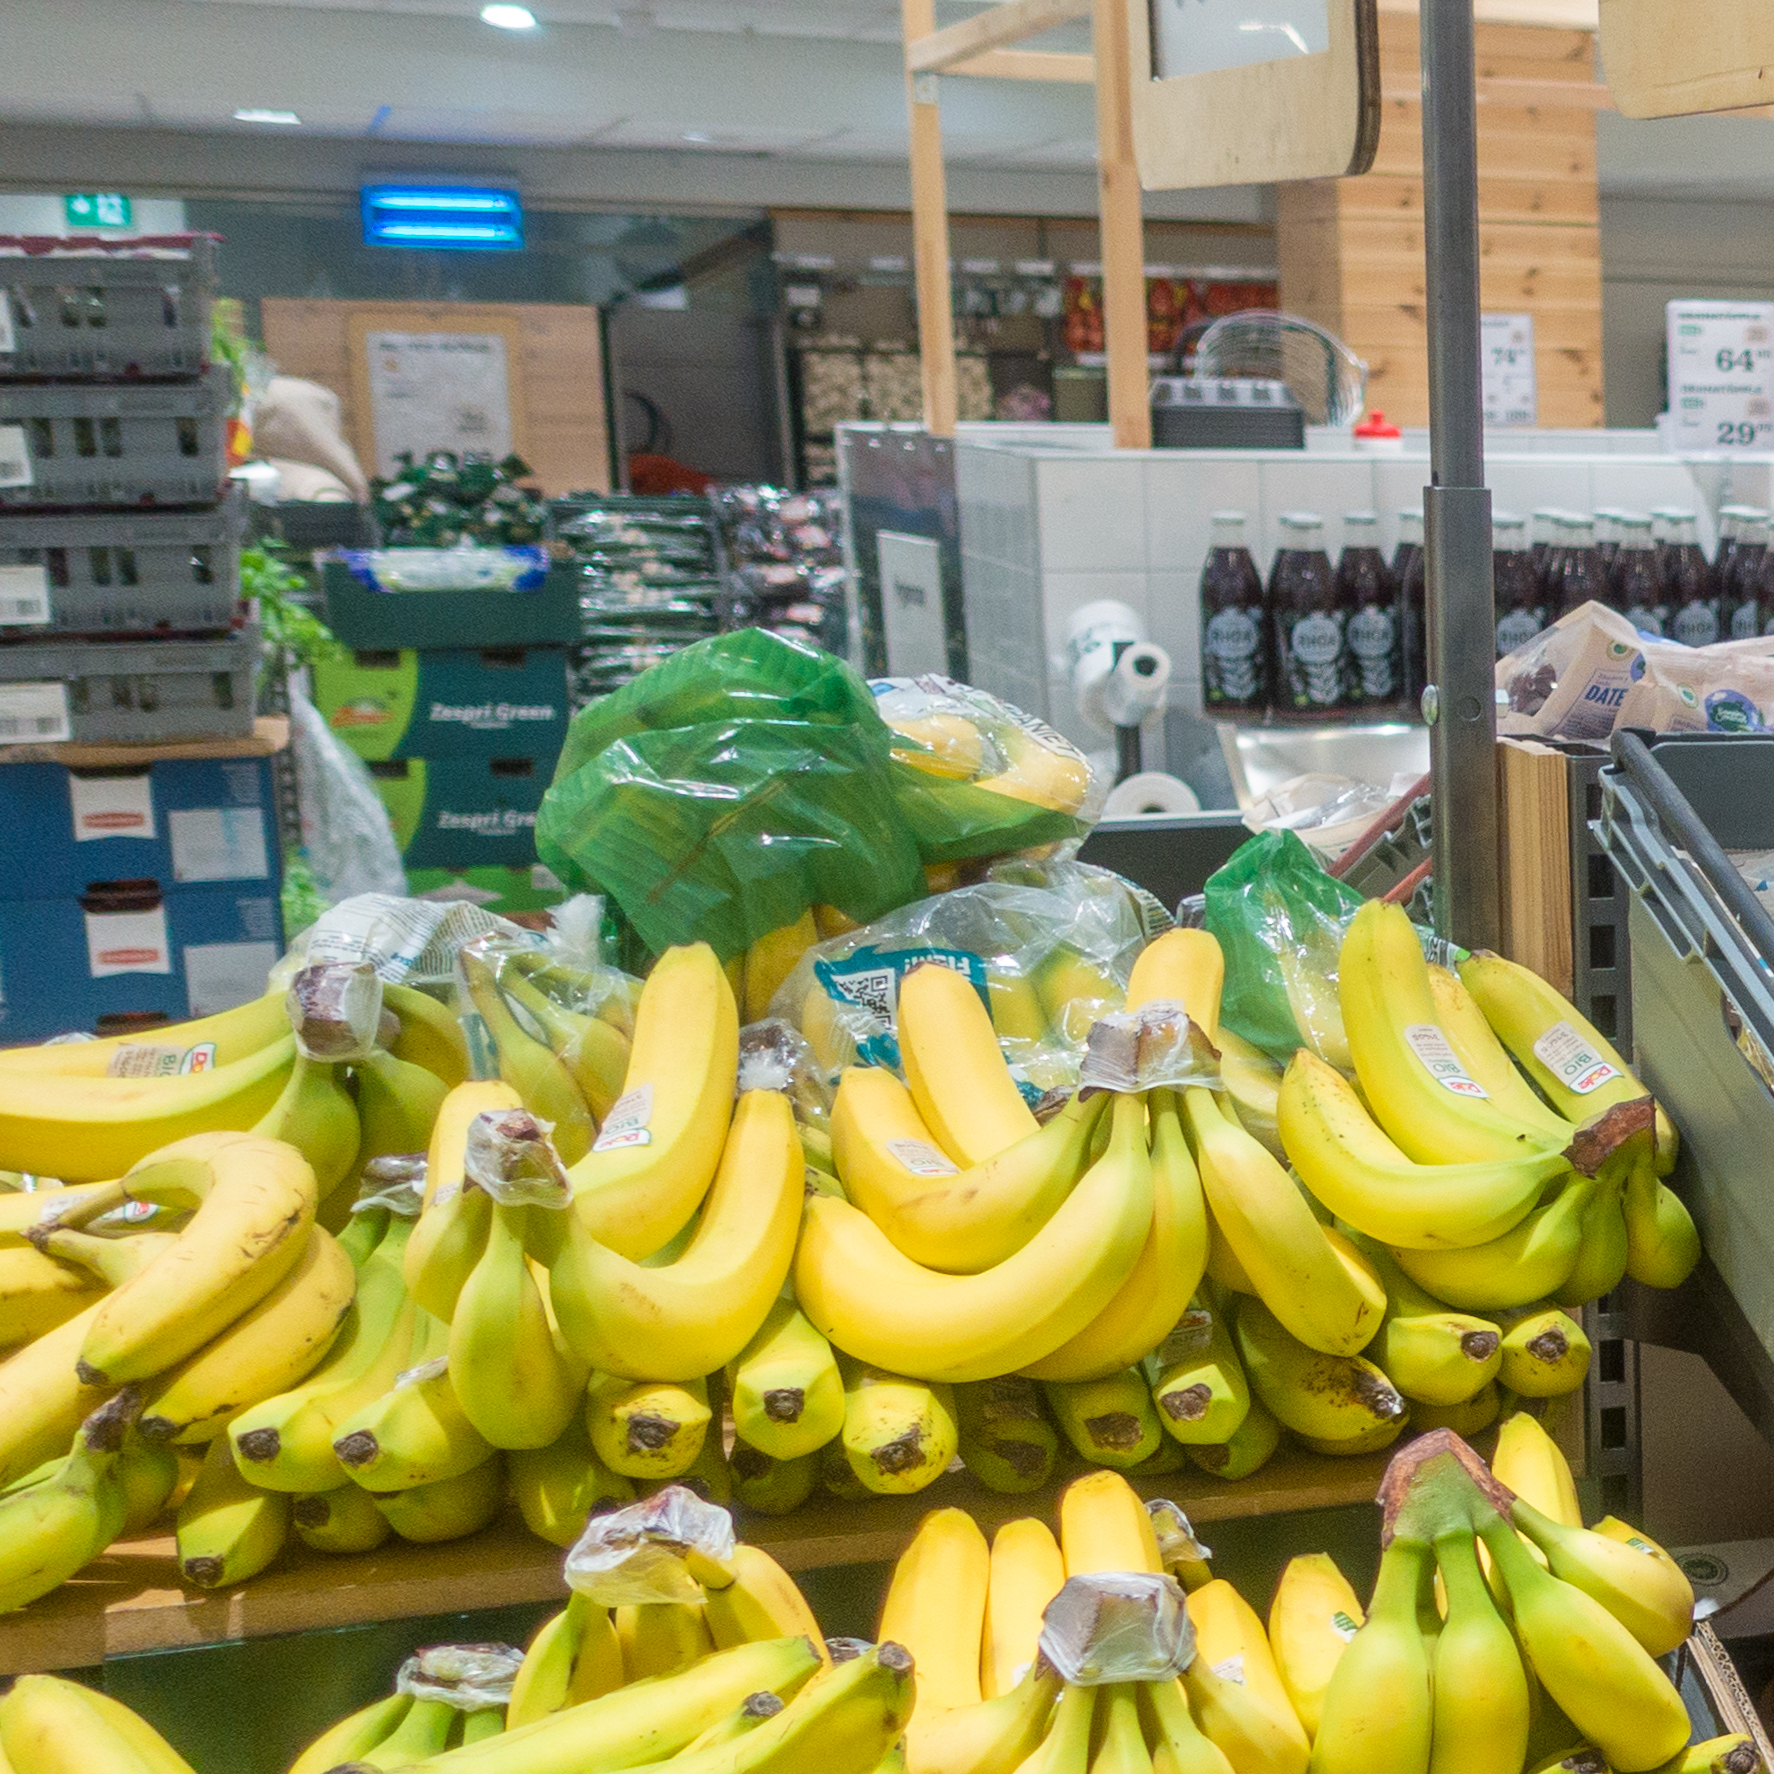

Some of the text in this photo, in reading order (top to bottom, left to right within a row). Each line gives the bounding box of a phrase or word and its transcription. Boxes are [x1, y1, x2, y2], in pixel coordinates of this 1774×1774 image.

[1716, 348, 1754, 372] 64
[1718, 421, 1755, 445] 29
[430, 702, 556, 722] Zespri Green
[437, 809, 536, 828] Zespri Gre
[1564, 1054, 1593, 1076] BIO
[1578, 1066, 1612, 1090] Dole
